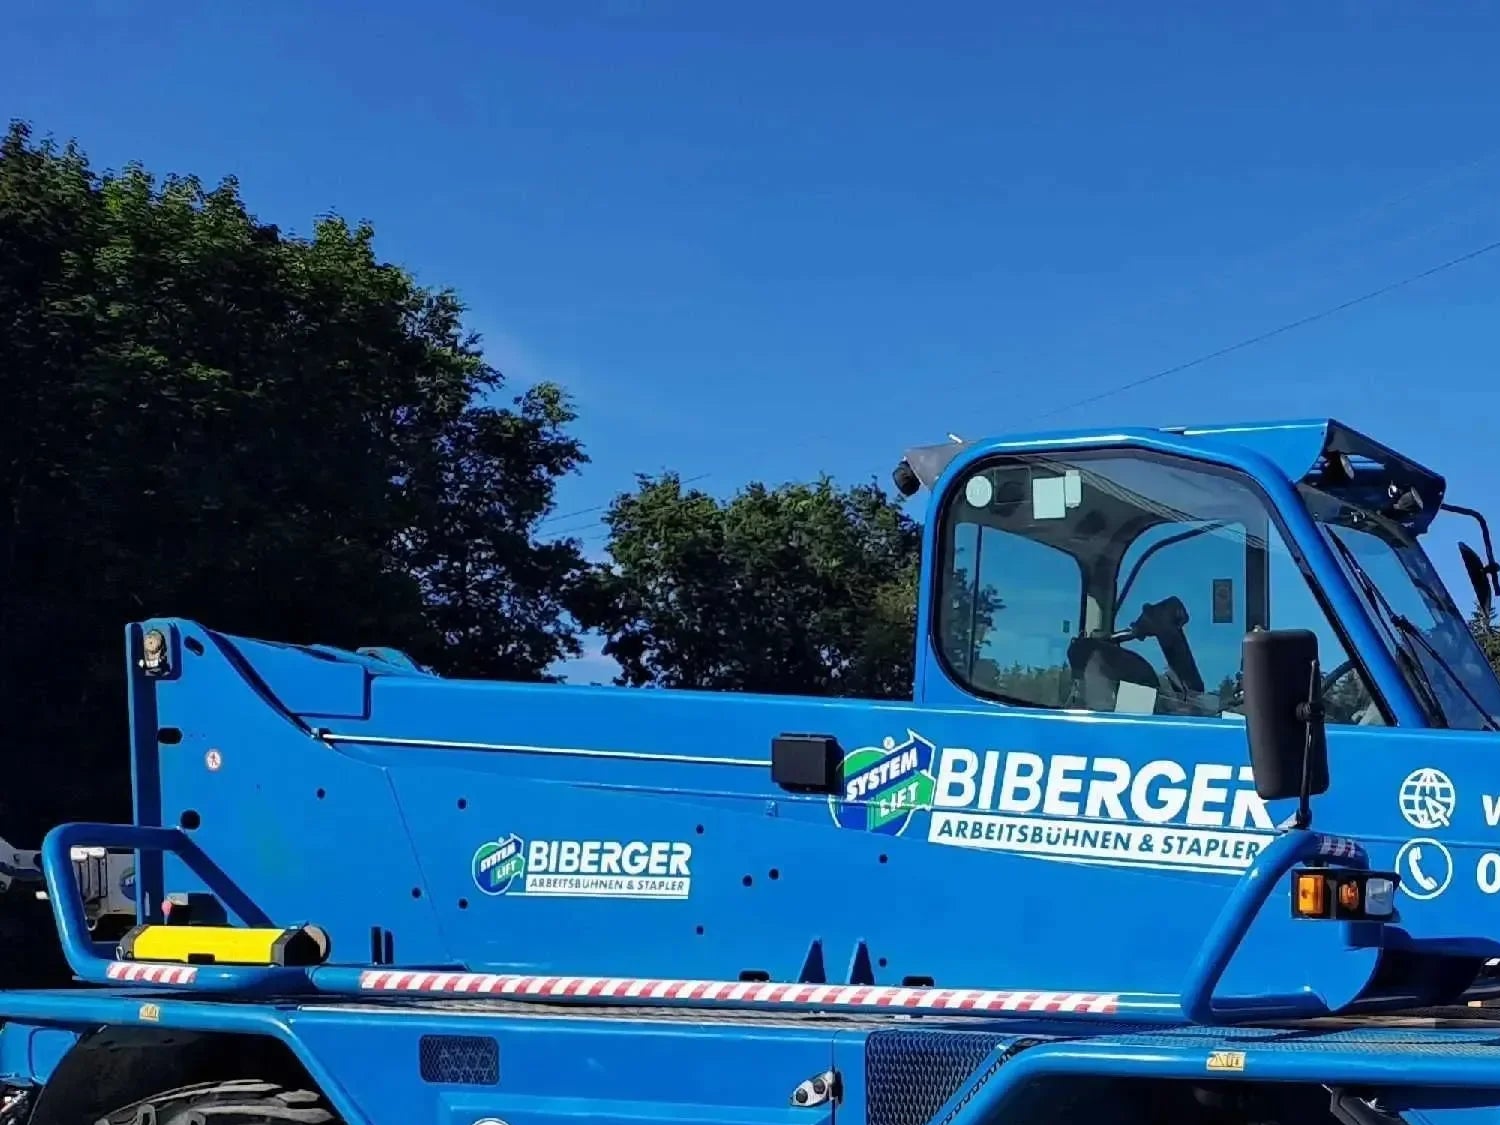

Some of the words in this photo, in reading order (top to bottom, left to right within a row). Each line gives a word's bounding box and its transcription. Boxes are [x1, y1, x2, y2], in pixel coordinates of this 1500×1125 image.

[846, 747, 918, 801] SYSTEM
[934, 747, 1275, 830] BIBERGER
[879, 781, 920, 818] LIFT
[527, 840, 692, 876] BIBERGER
[937, 818, 1132, 852] ARBEITSBÜHNEN
[1138, 833, 1155, 853] &
[1160, 835, 1261, 860] STAPLER
[626, 880, 634, 890] &
[637, 879, 685, 891] STAPLER
